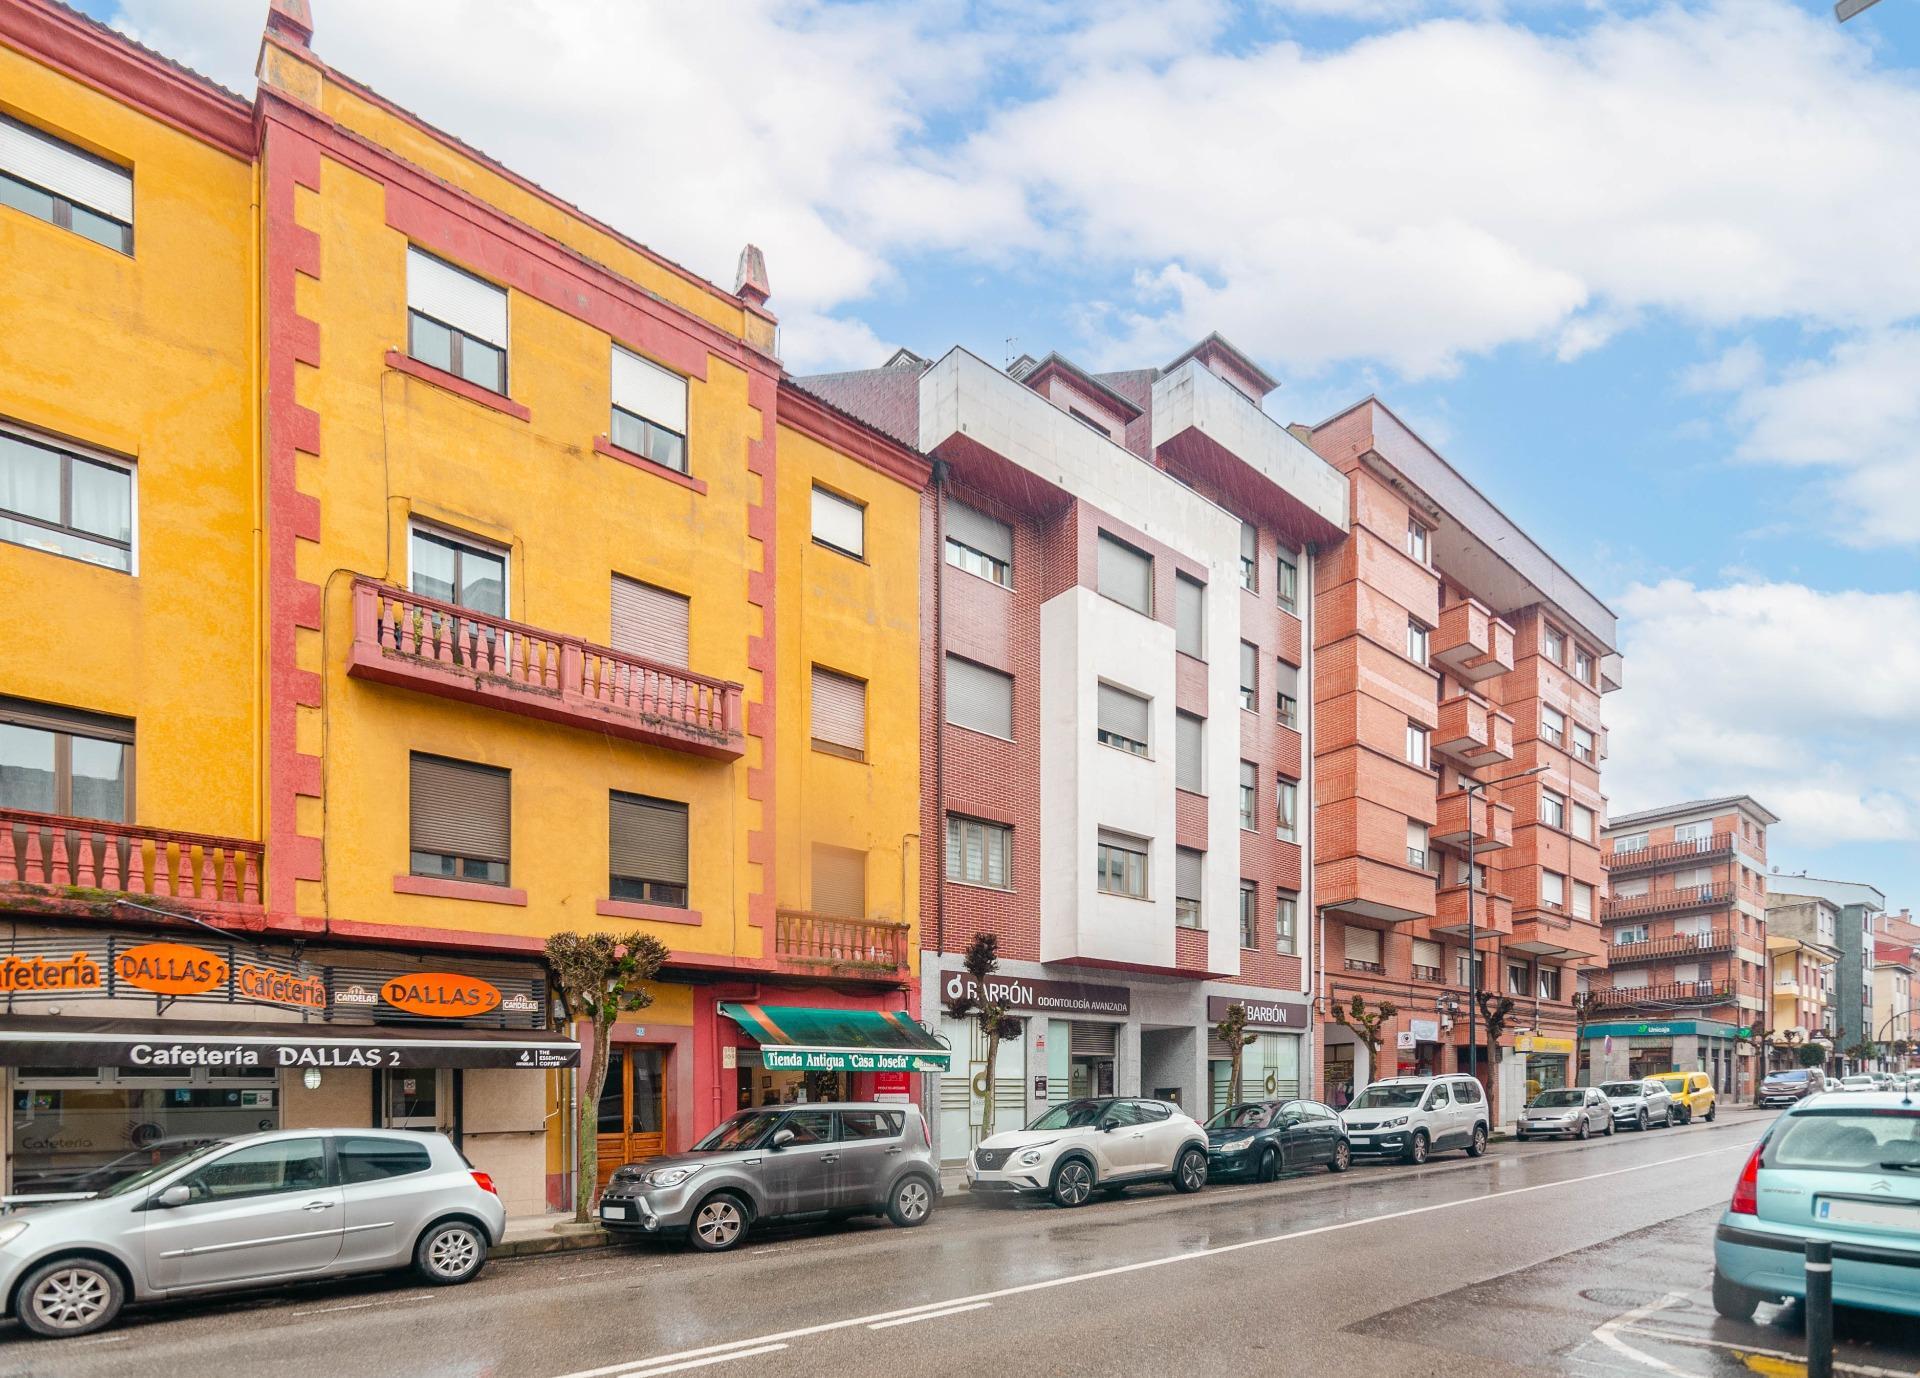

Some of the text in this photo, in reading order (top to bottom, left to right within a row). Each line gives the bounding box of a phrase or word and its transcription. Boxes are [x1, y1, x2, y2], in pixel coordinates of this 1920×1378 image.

[0, 954, 97, 987] fetería
[120, 955, 225, 984] DALLAS 2
[242, 968, 324, 1004] Cafetería
[389, 983, 495, 1006] DALLAS 2
[336, 993, 376, 1003] CANDELAS
[504, 1001, 537, 1010] CANDELAS
[1038, 996, 1128, 1012] ODONTOLOGÍA AVANZADA
[1247, 1004, 1287, 1023] BARBÓN
[130, 1044, 401, 1067] Cafetería DALLAS 2
[768, 1052, 803, 1066] Tienda
[806, 1053, 845, 1070] Antigua
